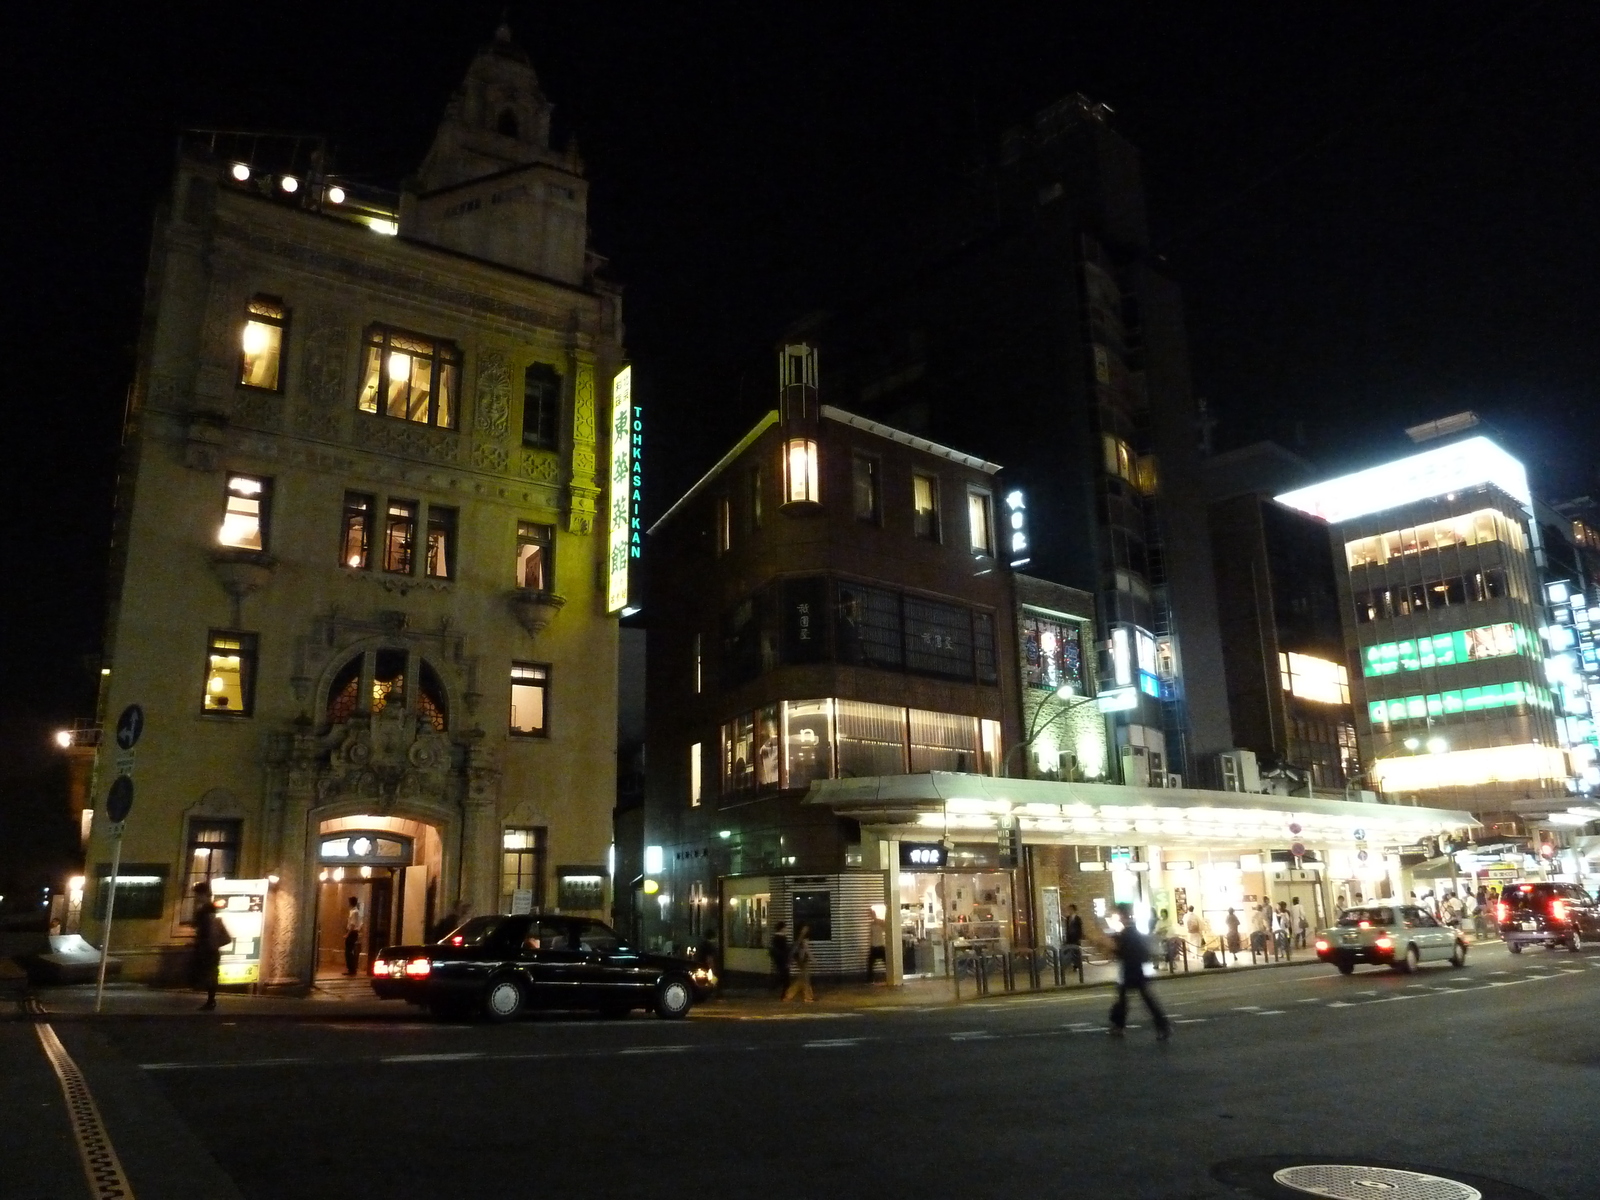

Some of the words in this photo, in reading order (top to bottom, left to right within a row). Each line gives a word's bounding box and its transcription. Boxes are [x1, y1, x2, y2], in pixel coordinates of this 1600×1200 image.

[611, 410, 629, 575] 東華菜館
[631, 406, 643, 558] TOHKASAIKAN
